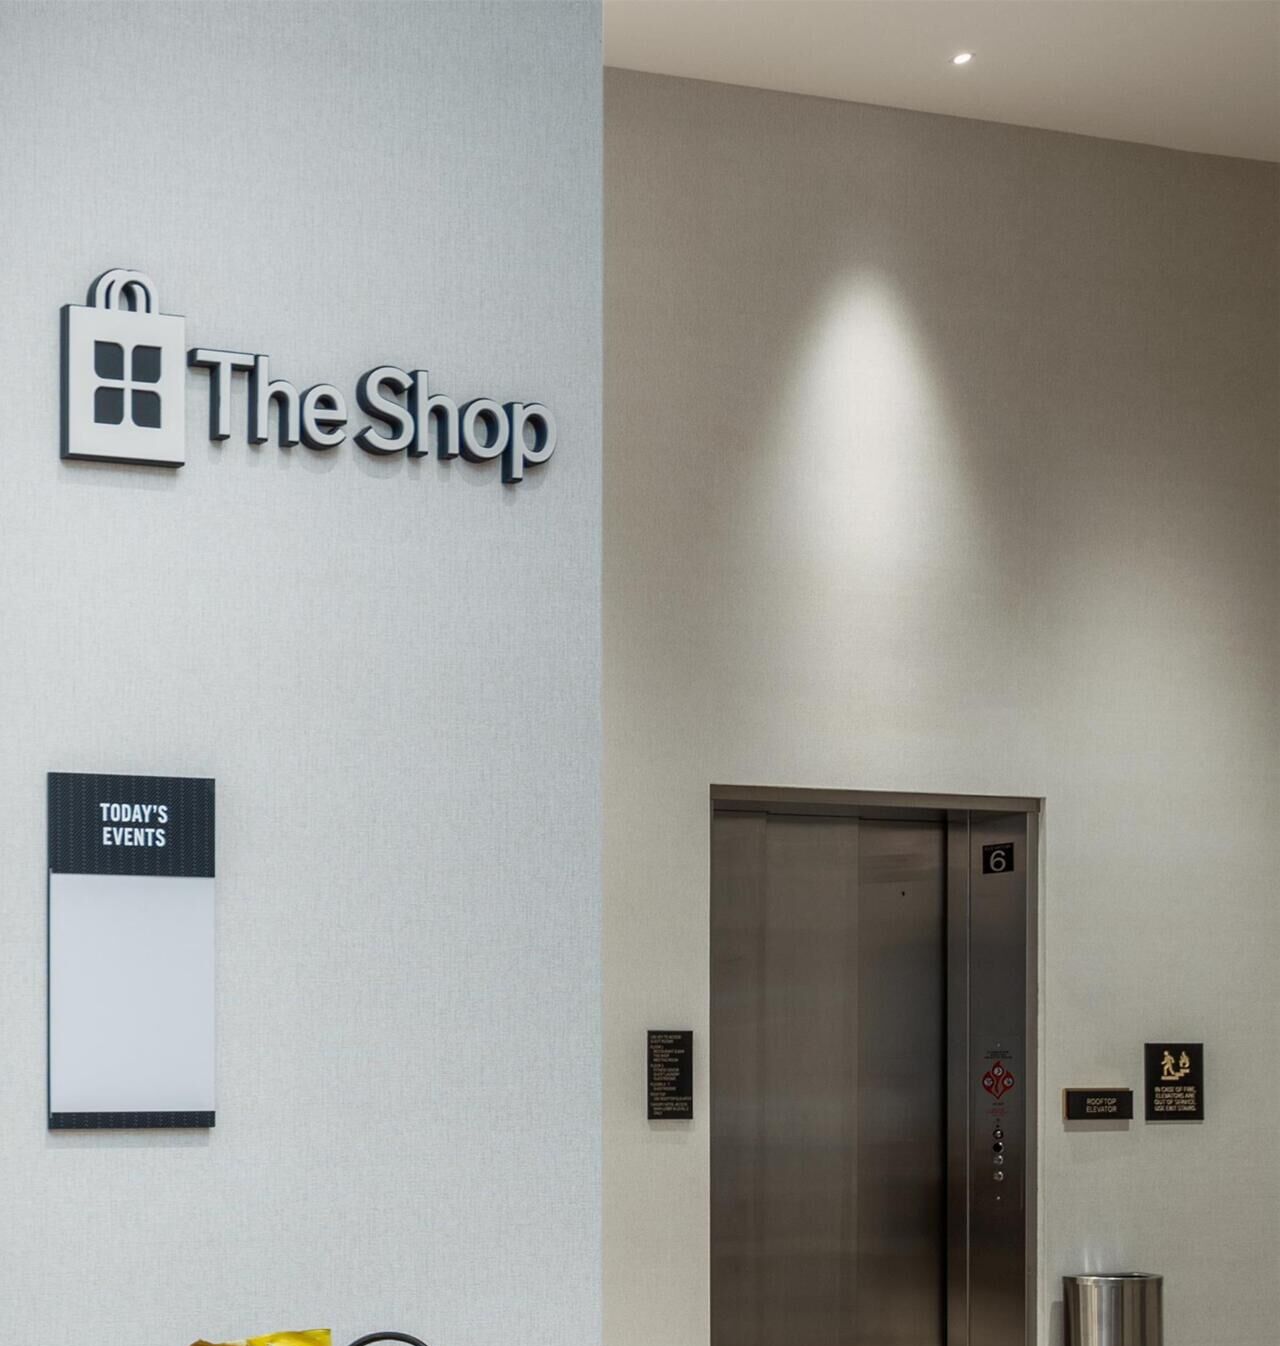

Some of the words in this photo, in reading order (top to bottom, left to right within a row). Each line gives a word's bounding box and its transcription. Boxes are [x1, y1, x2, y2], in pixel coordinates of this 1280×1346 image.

[187, 348, 347, 451] The
[353, 365, 558, 484] Shop
[100, 803, 169, 824] TODAY'S
[102, 827, 166, 847] EVENTS
[990, 850, 1006, 871] 6
[1086, 1098, 1117, 1106] ROOFTOP
